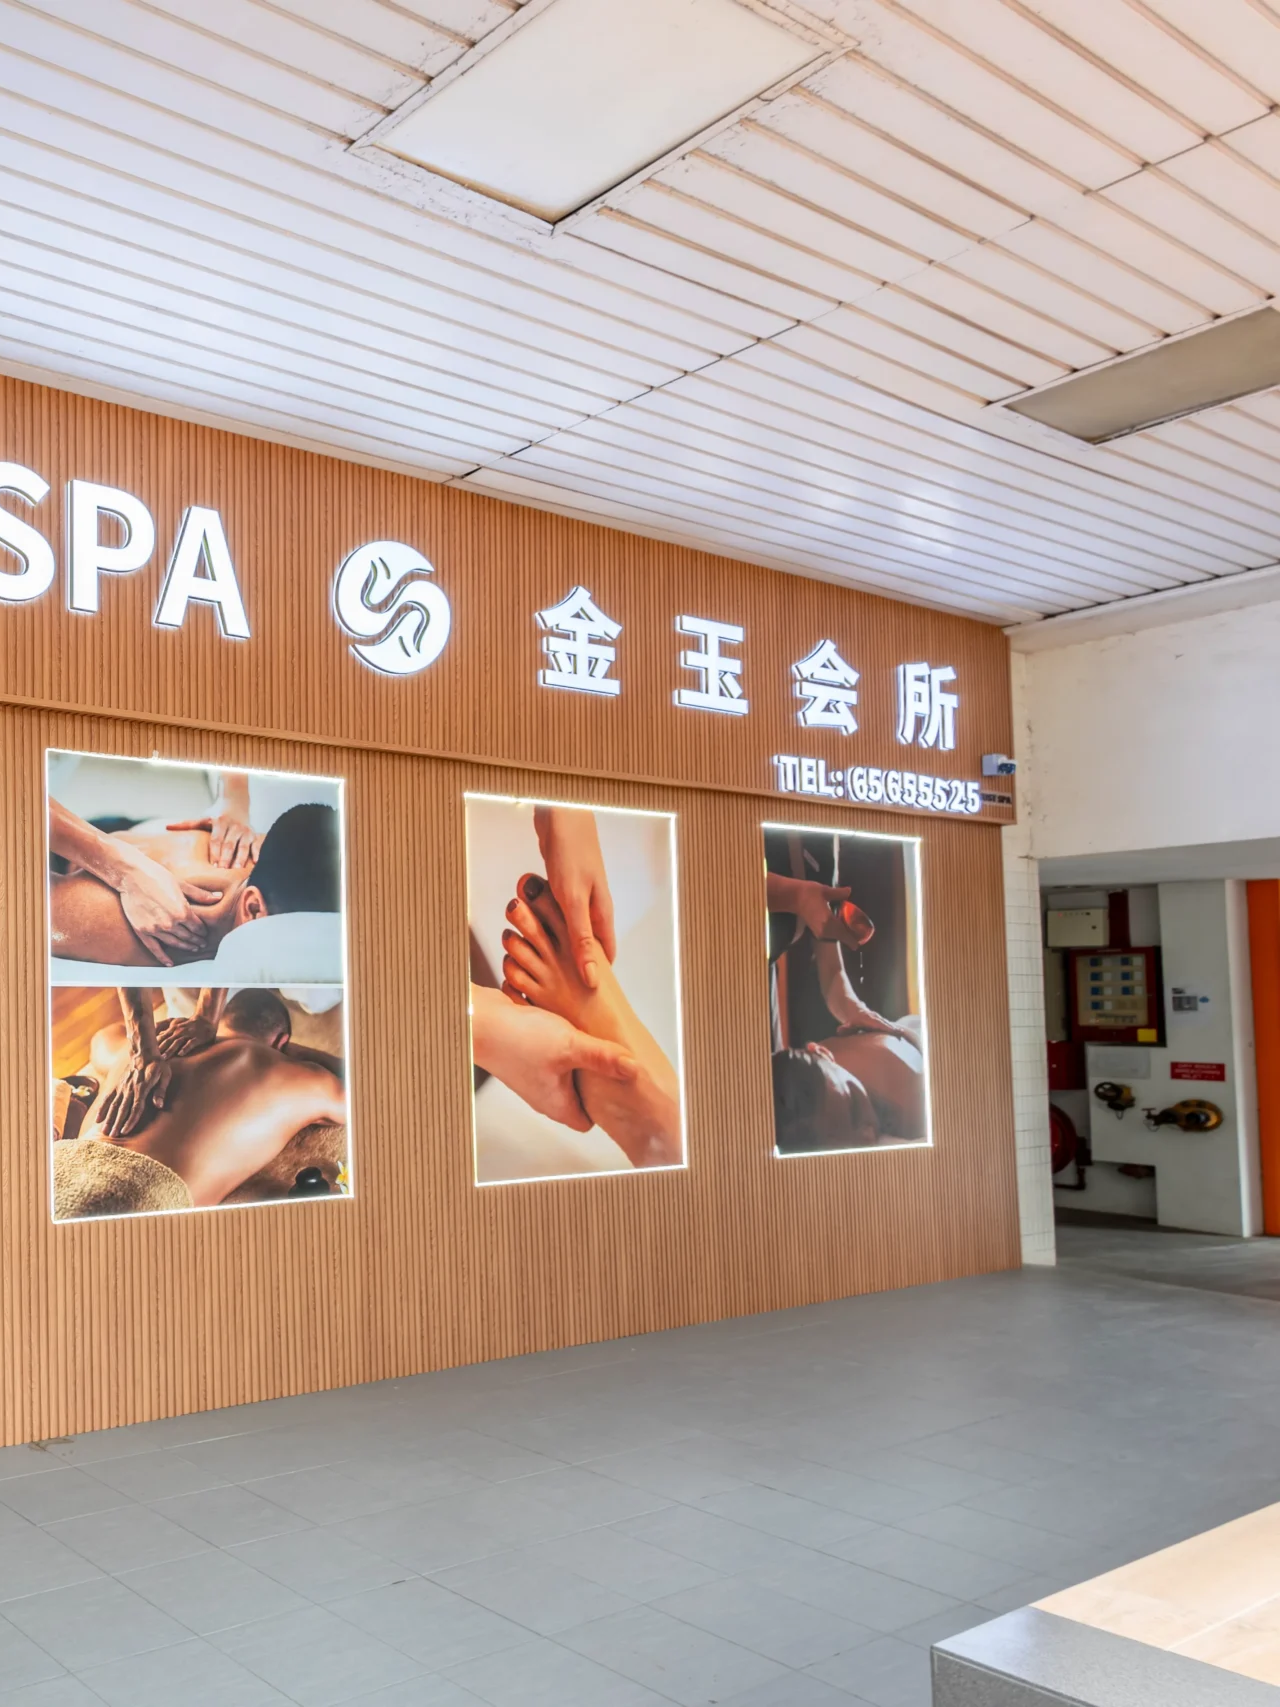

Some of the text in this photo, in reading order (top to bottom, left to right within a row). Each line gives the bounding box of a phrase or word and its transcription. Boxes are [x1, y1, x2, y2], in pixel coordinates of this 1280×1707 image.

[534, 585, 960, 751] 金玉会所
[773, 755, 844, 797] TEL:
